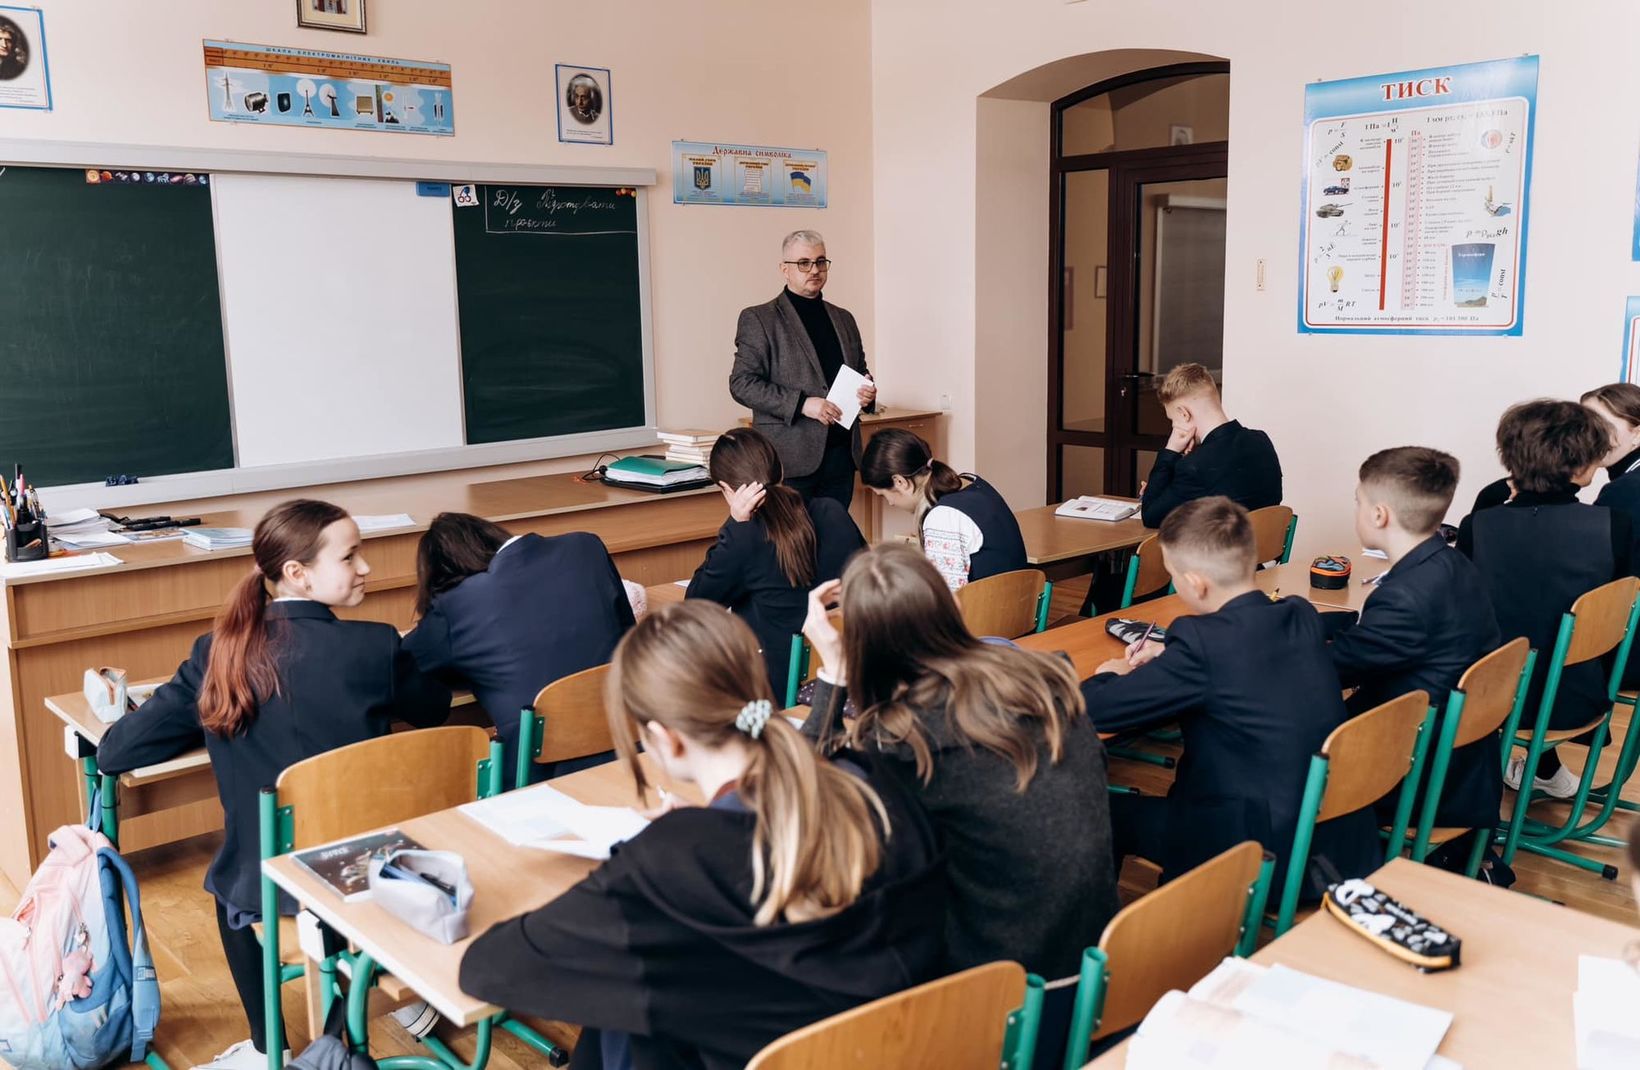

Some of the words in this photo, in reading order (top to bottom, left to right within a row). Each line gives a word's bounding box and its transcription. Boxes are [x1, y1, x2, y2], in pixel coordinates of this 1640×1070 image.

[1381, 76, 1450, 100] ТИСК
[711, 145, 752, 156] Державна
[755, 149, 792, 159] символіка
[493, 189, 523, 215] Д/з
